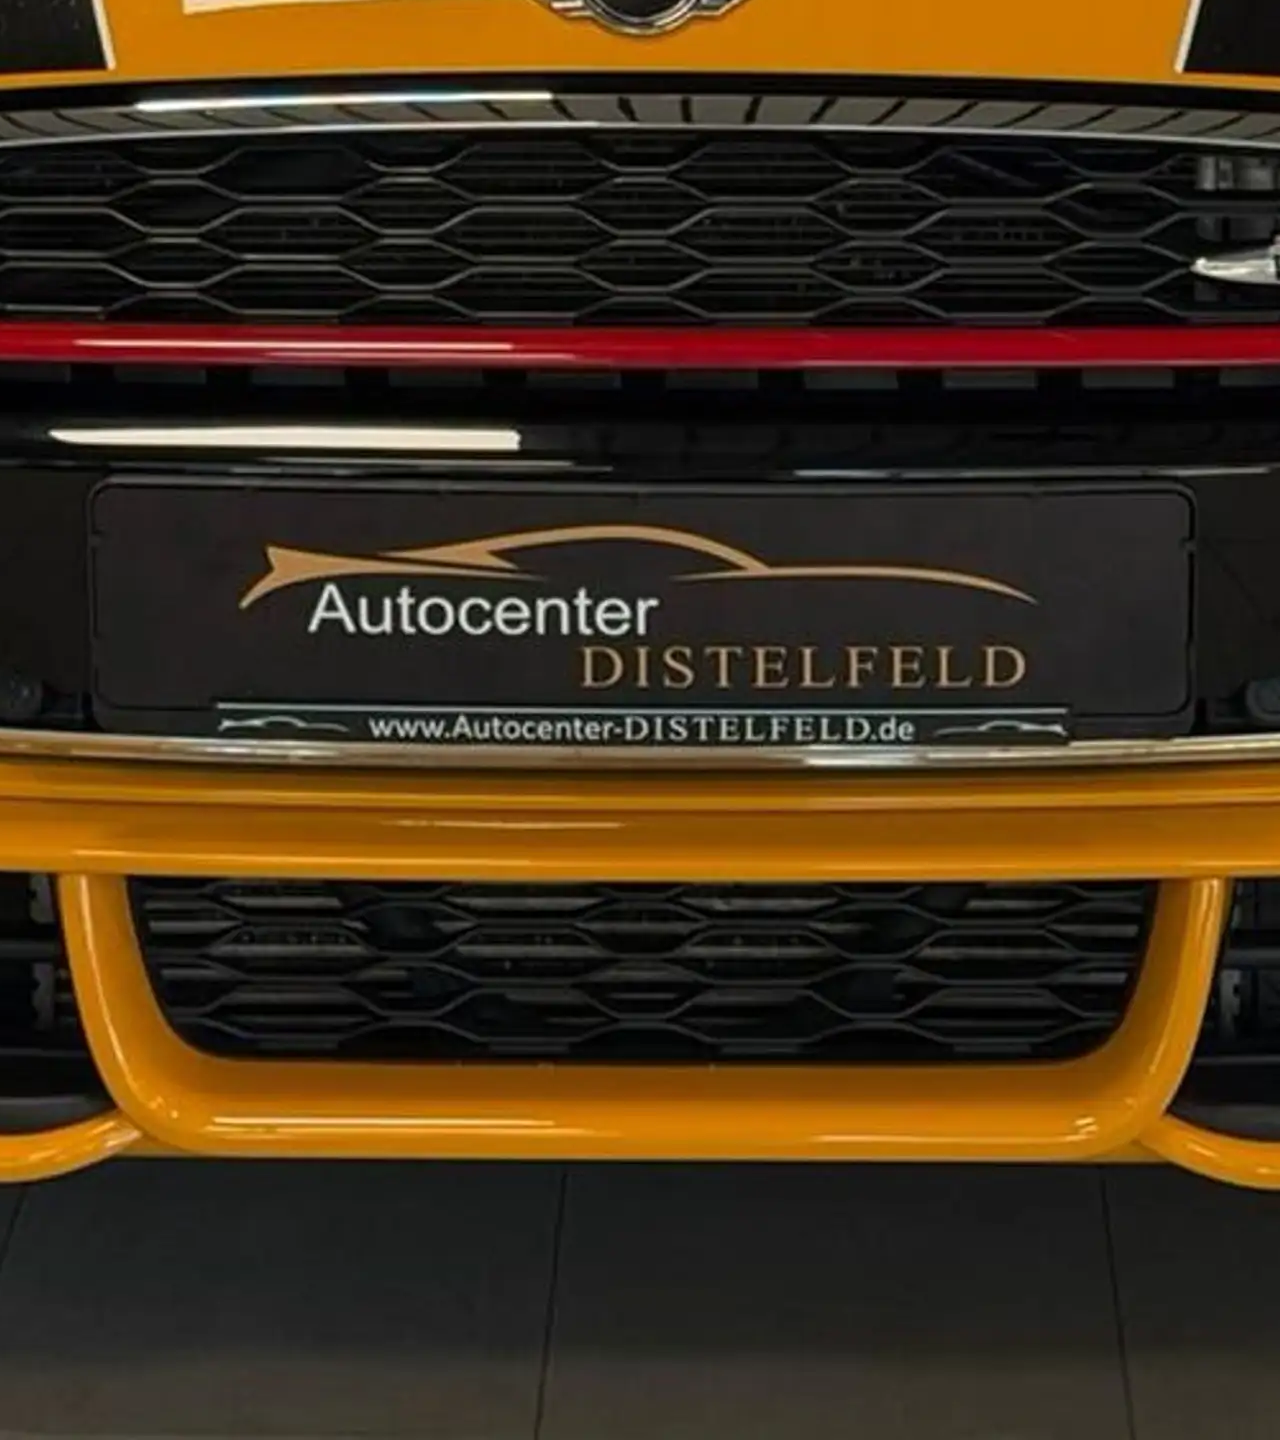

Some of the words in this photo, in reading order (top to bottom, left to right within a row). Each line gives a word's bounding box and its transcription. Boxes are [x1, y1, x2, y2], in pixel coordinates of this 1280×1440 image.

[307, 582, 659, 636] Autocenter
[580, 645, 1027, 689] DISTELFELD
[368, 713, 915, 742] www.Autocenter-DISTELFELD.de
